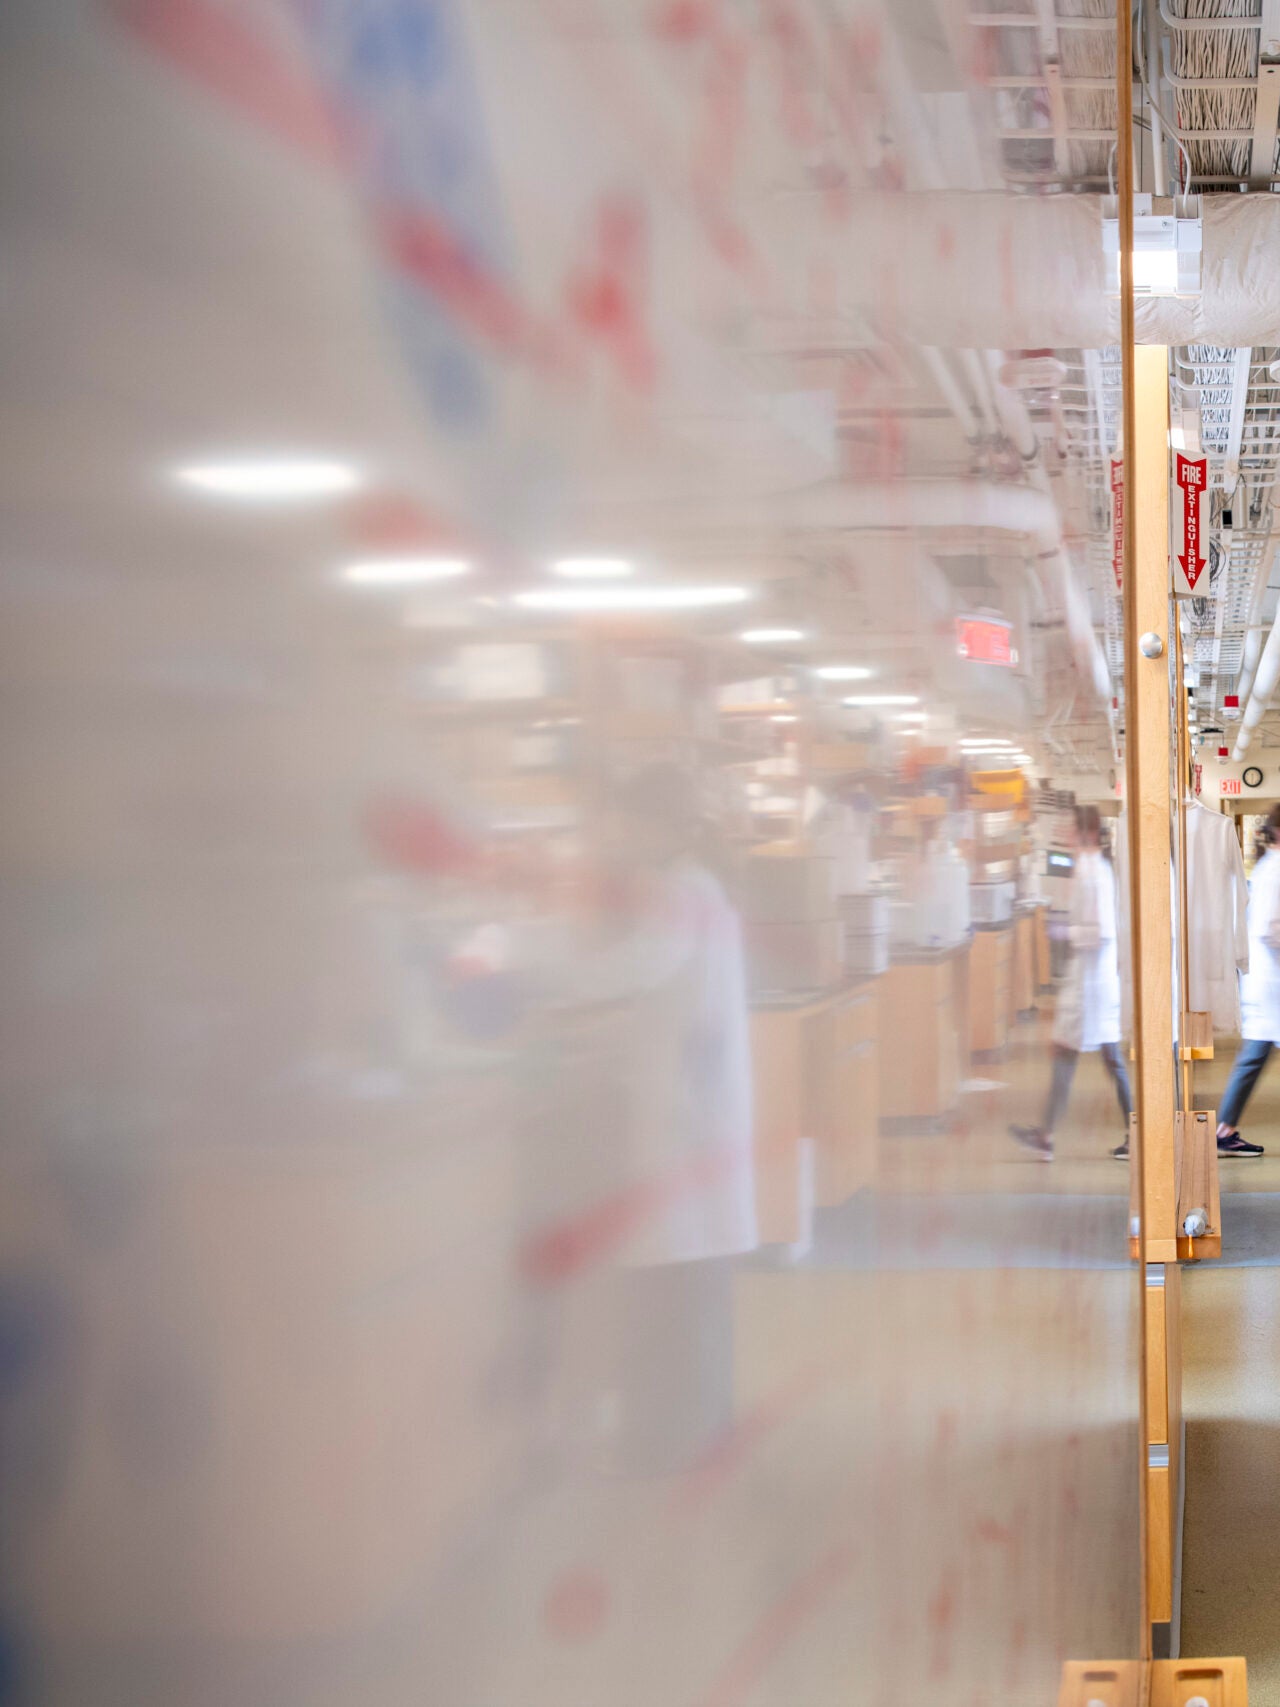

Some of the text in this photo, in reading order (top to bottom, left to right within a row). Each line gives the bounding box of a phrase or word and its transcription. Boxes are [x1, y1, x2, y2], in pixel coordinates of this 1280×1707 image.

[1181, 463, 1202, 485] FIRE
[1187, 484, 1196, 580] EXTINGUISHER
[1220, 779, 1241, 795] EXIT
